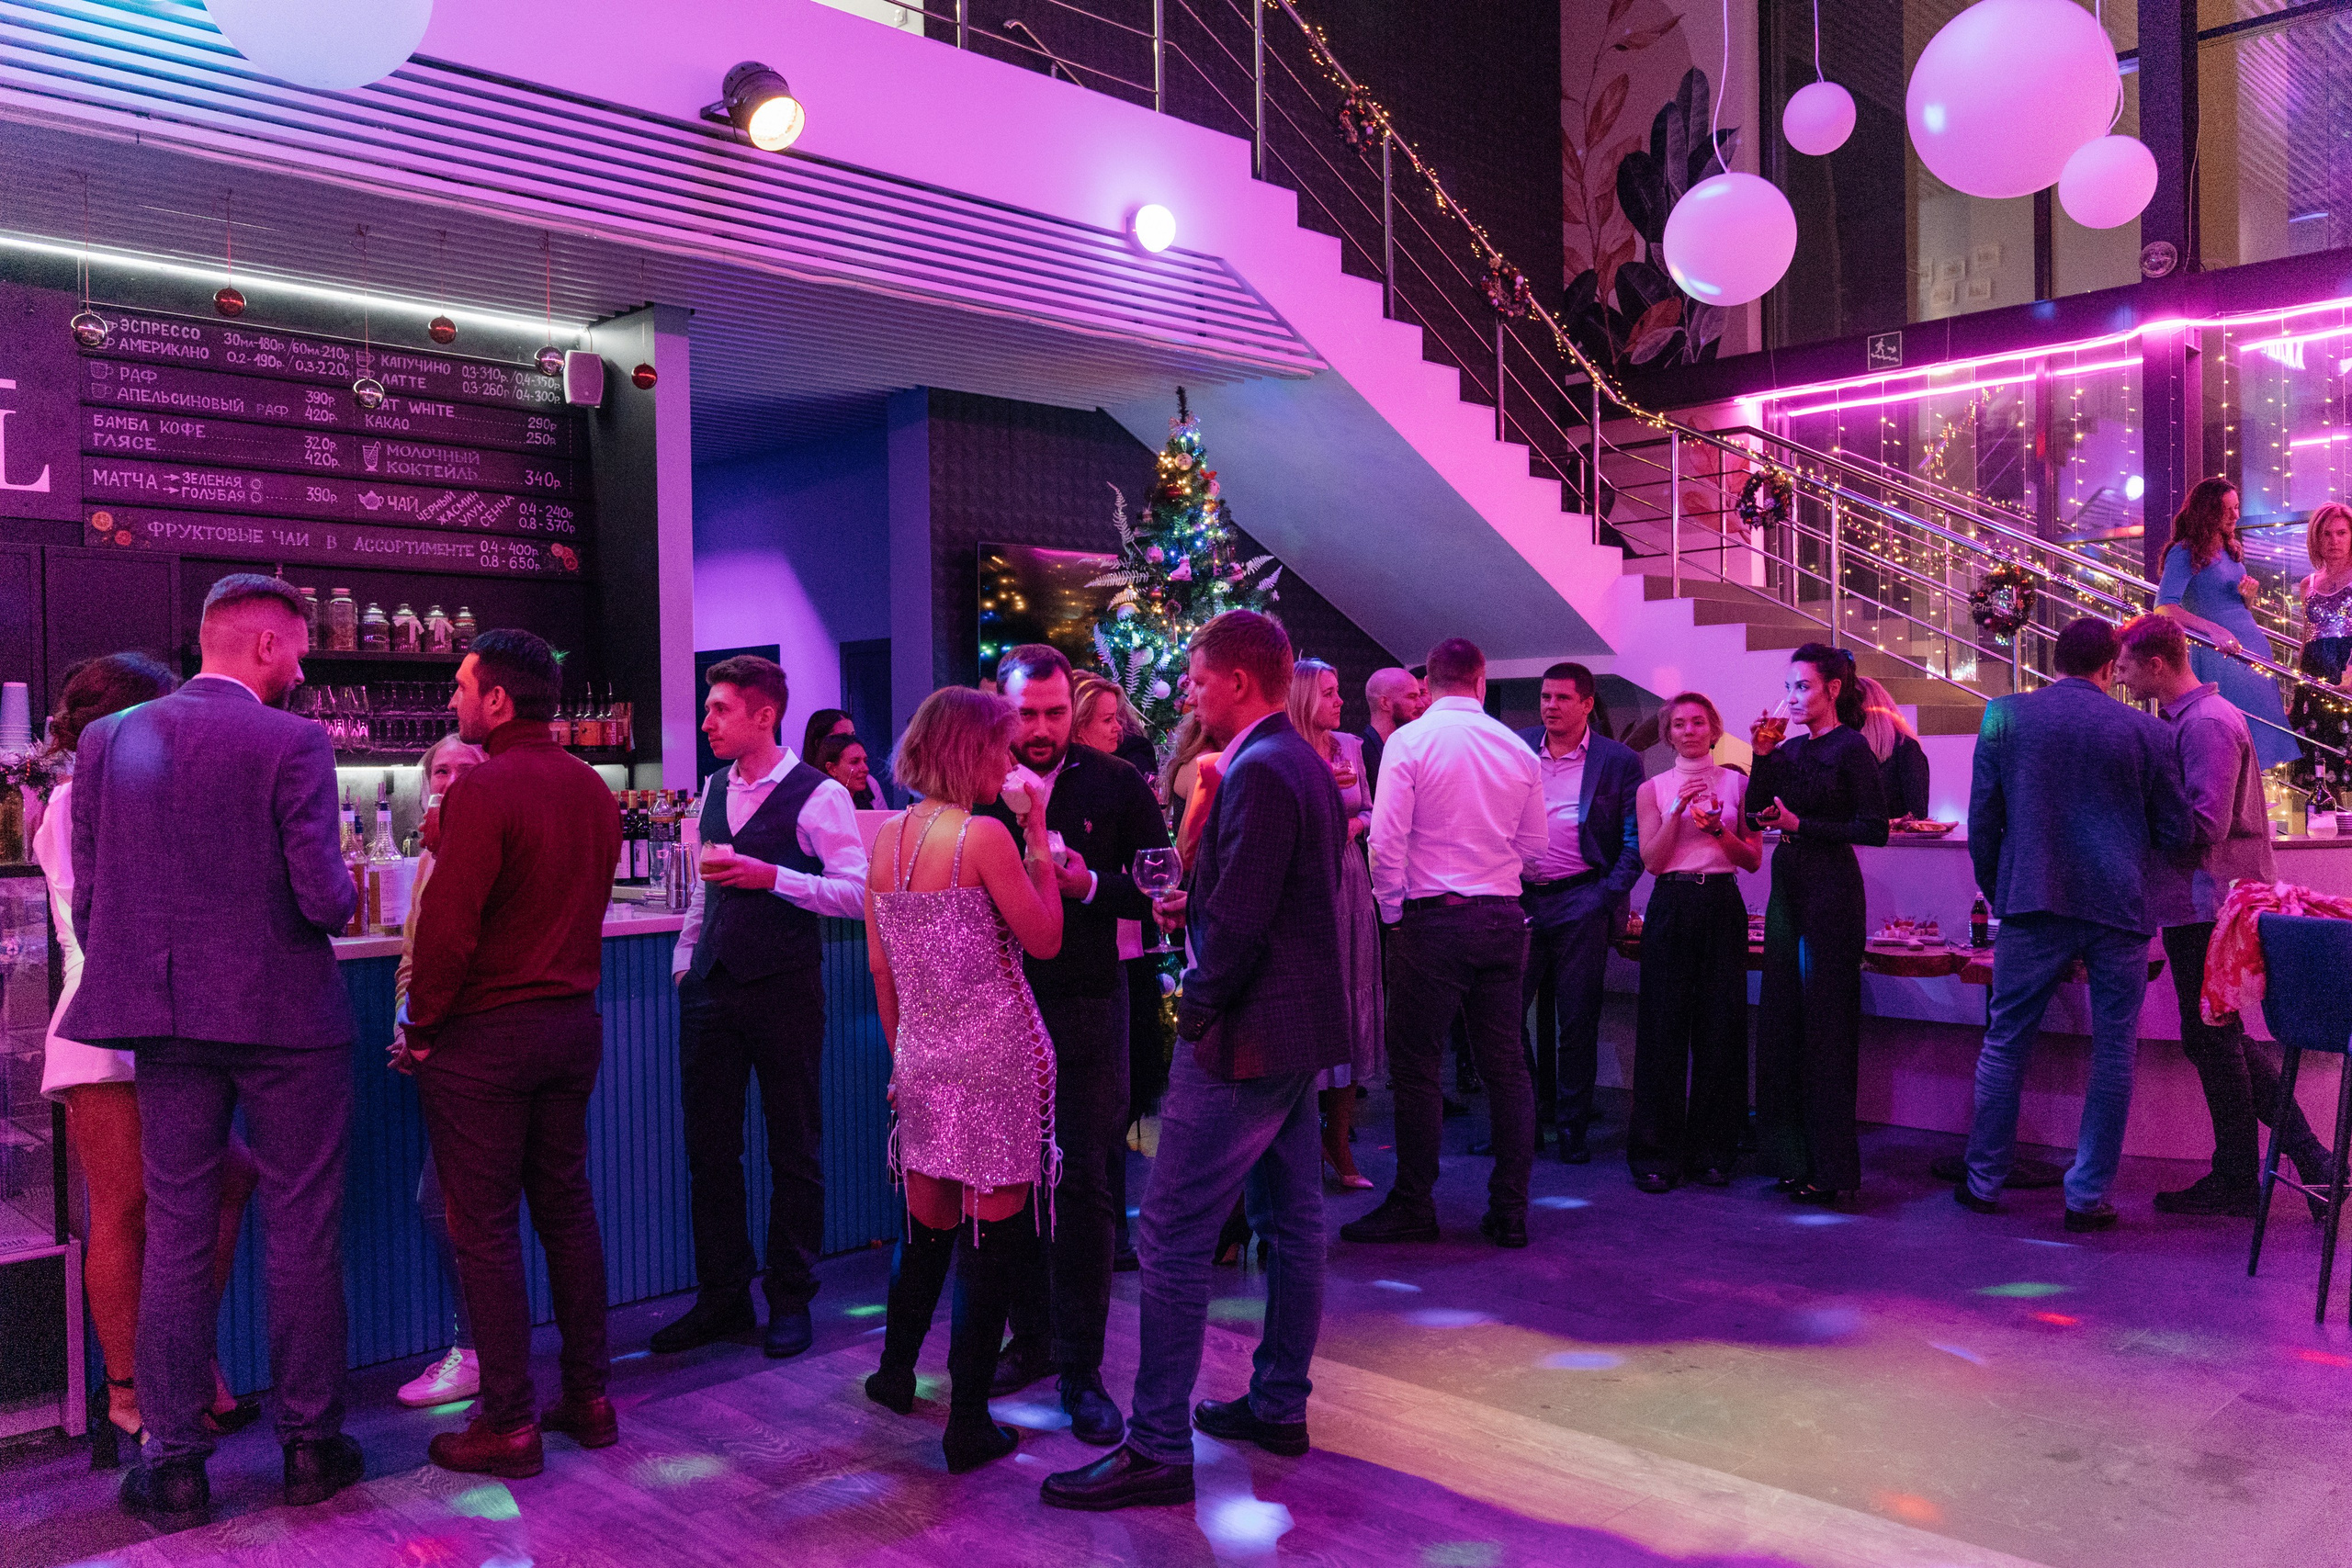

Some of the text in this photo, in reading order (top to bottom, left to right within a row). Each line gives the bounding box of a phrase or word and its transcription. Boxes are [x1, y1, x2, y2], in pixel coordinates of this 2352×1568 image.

[120, 318, 200, 341] ЭСПРЕССО
[119, 337, 209, 360] АМЕРИКАНО
[119, 367, 157, 384] РАФ
[380, 355, 451, 375] КАПУЧИНО
[380, 372, 427, 389] ЛАТТЕ
[117, 387, 244, 412] АПЕЛЬСИНОВЫЙ
[256, 402, 288, 417] РАФ
[408, 401, 455, 418] WHITE
[93, 413, 149, 432] БАМБЛ
[160, 420, 206, 438] КОФЕ
[365, 413, 410, 431] КАКАО
[93, 433, 157, 451] ГЛЯСЕ
[386, 444, 481, 466] МОЛОЧНЫЙ
[93, 468, 243, 490] МАТЧА ЗЕЛЕНАЯ
[386, 461, 478, 480] КОКТЕЙЛЬ
[181, 486, 245, 502] ГОЛУБАЯ
[387, 495, 419, 513] ЧАЙ
[416, 491, 457, 522] ЧЕРНЫЙ
[436, 491, 480, 525] ЖАСМИН
[458, 500, 487, 527] УЛУН
[480, 494, 515, 527] СЕНЧА
[147, 521, 264, 543] ФРУКТОВЫЕ
[271, 530, 309, 547] ЧАИ
[326, 535, 337, 549] В
[353, 536, 475, 557] АССОРТИМЕНТЕ
